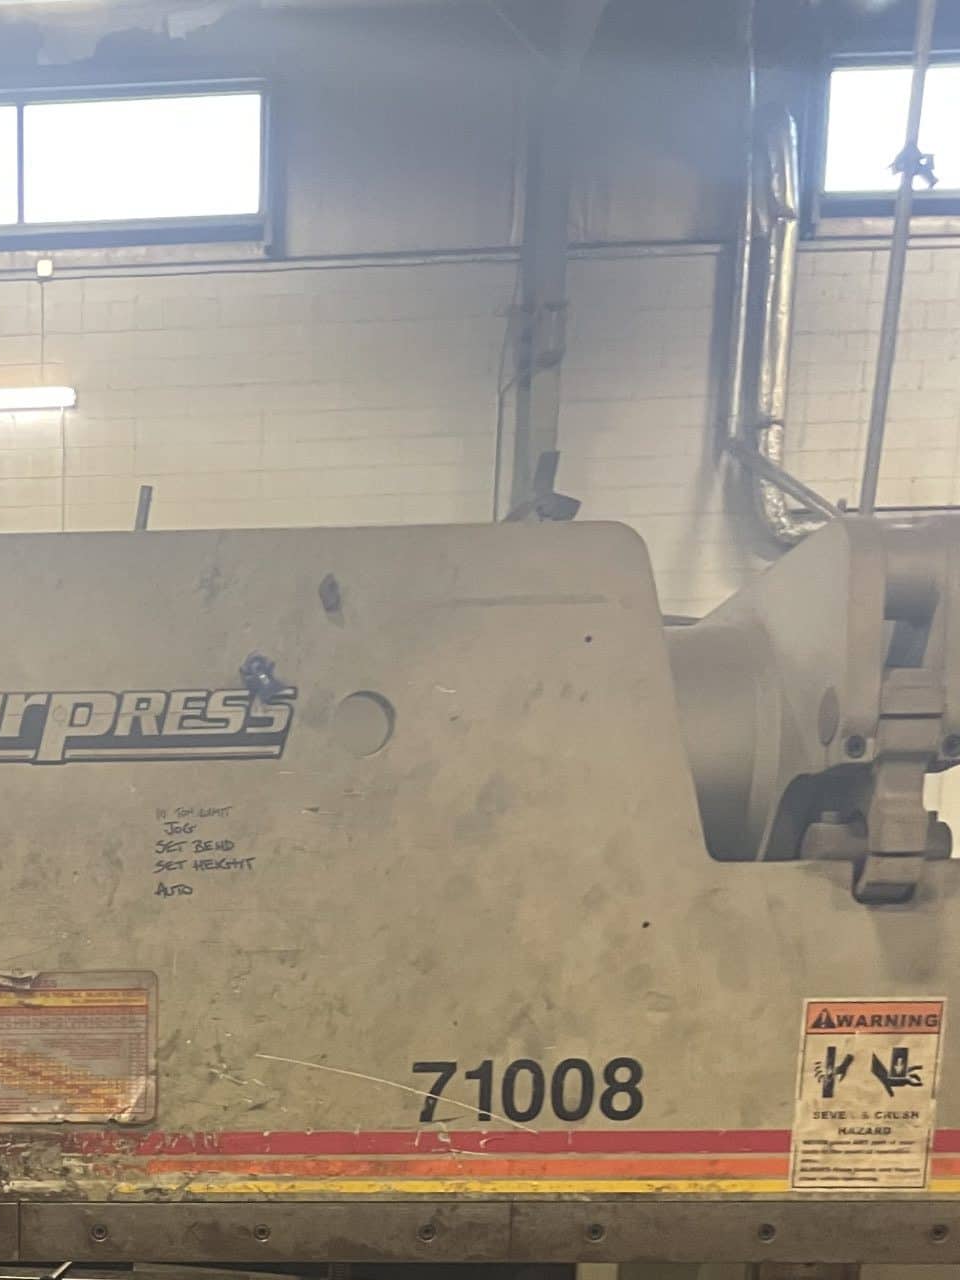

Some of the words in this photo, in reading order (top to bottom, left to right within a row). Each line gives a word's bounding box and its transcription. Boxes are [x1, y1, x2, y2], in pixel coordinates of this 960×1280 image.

[164, 820, 197, 836] JOG
[155, 840, 188, 854] SET
[191, 839, 235, 853] BEND
[152, 859, 188, 874] SET
[153, 882, 193, 899] AUTO
[835, 1013, 939, 1029] WARNING
[412, 1057, 644, 1123] 71008
[837, 1126, 892, 1136] HAZARD
